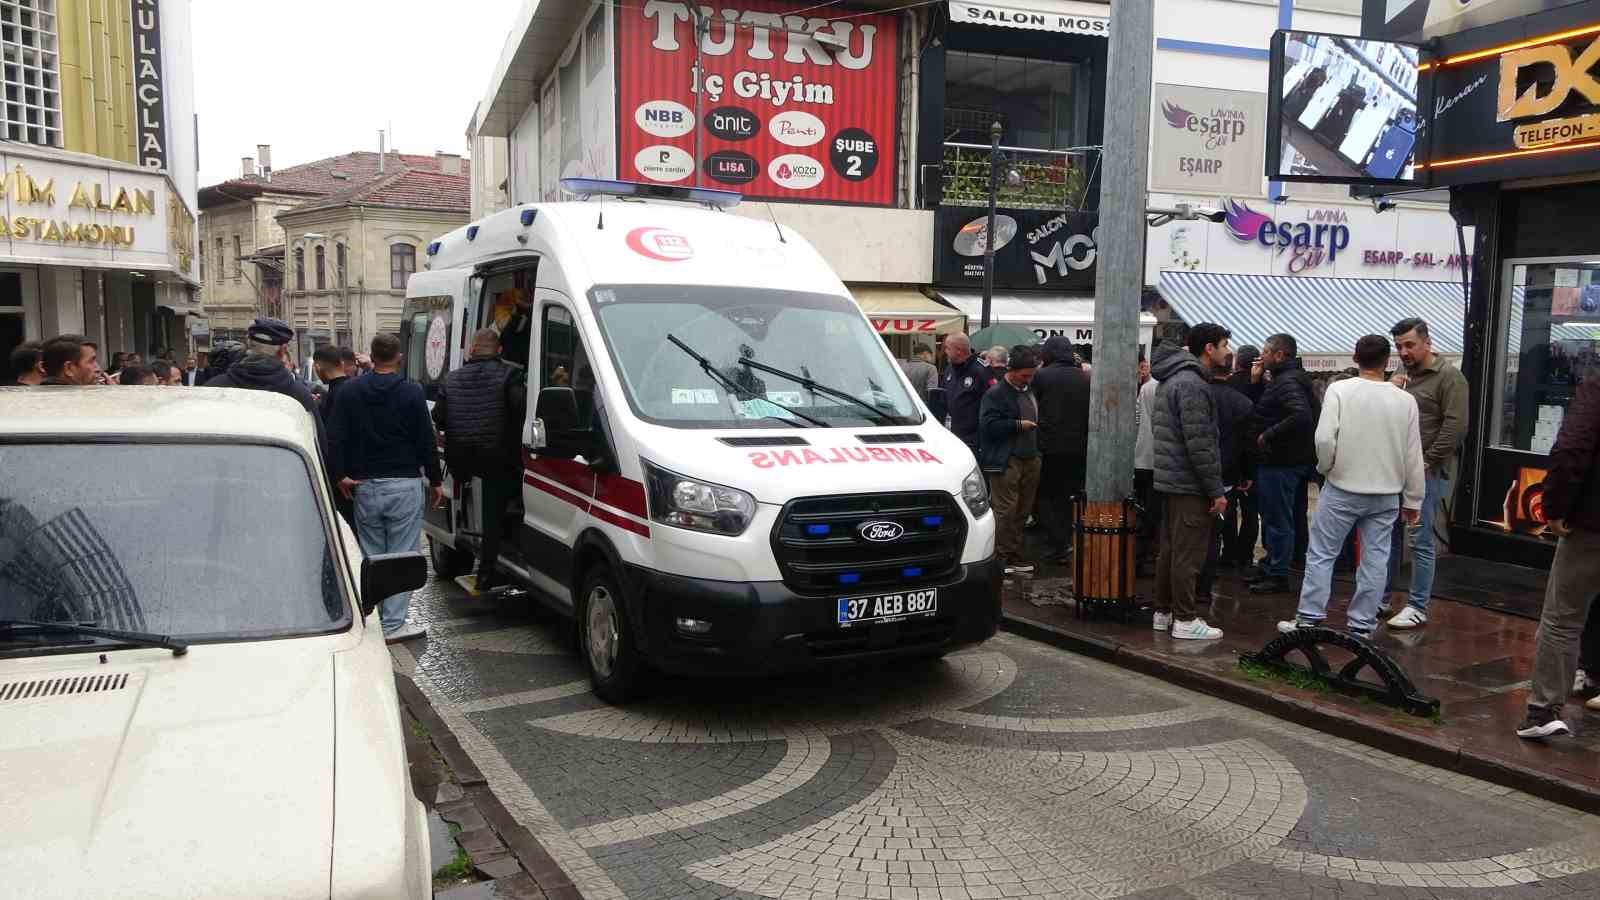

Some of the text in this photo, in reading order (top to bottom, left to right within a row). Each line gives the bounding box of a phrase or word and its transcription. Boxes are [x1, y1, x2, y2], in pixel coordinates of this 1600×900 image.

[967, 7, 1111, 31] SALON MOS
[643, 1, 877, 70] TUTKU
[138, 0, 163, 171] ULAÇLAR
[733, 71, 834, 106] Giyim
[645, 109, 683, 123] NBB
[836, 138, 874, 153] ŞUBE
[1520, 123, 1583, 144] TELEFON
[719, 160, 746, 172] LISA
[846, 155, 862, 176] 2
[1179, 156, 1222, 176] EŞARP
[67, 181, 156, 216] ALAN
[1027, 213, 1068, 244] SALON
[1030, 226, 1101, 285] MO
[869, 524, 896, 538] Ford
[847, 599, 868, 619] 37
[874, 595, 903, 616] AEB
[907, 590, 935, 611] 887
